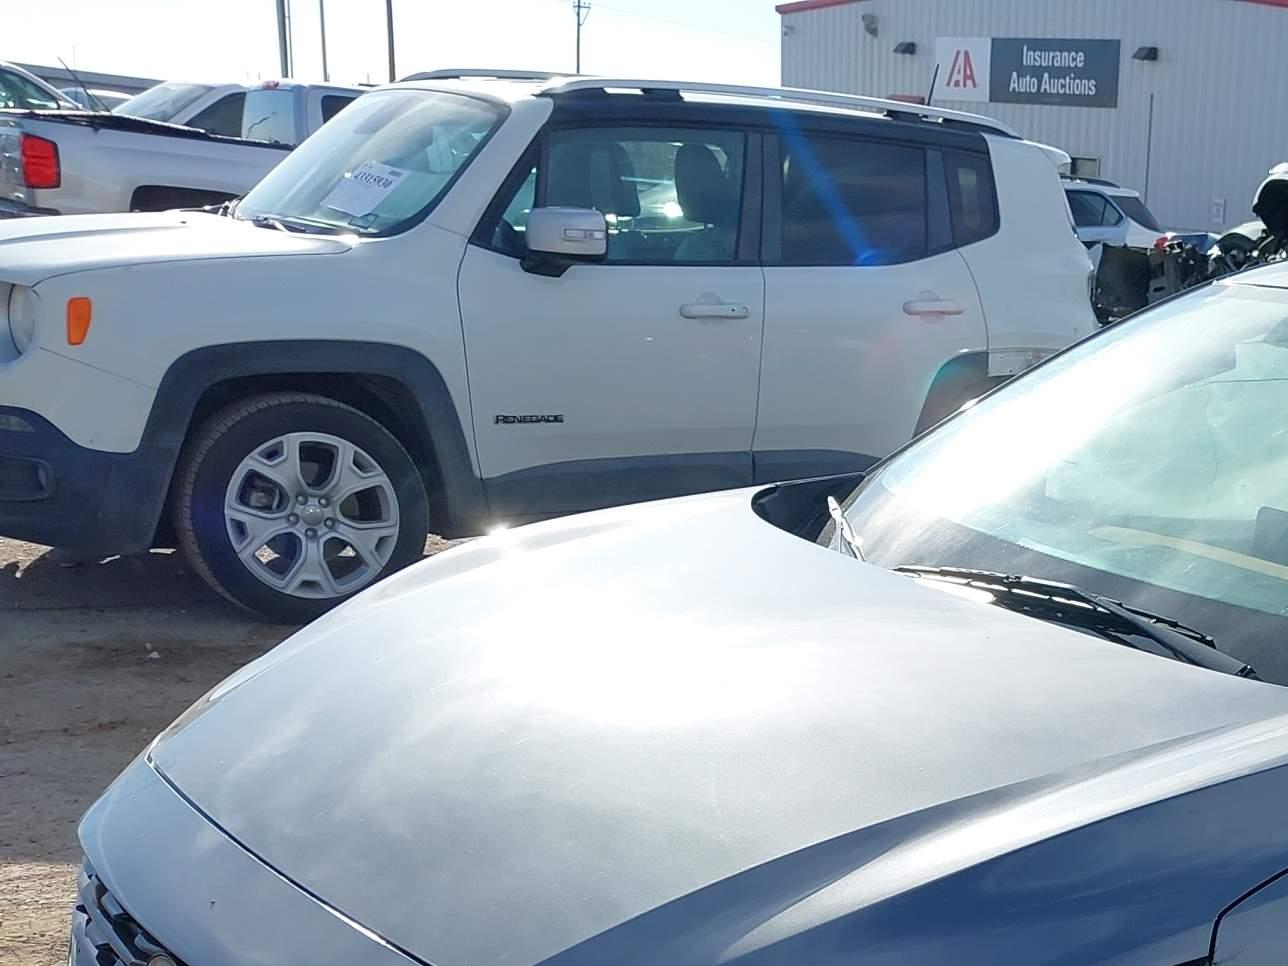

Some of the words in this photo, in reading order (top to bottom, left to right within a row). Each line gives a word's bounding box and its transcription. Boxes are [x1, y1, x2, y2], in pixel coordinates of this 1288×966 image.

[1022, 45, 1084, 67] Insurance
[1009, 72, 1038, 93] Auto
[1040, 72, 1096, 96] Auctions
[494, 414, 564, 425] RENEGADE
